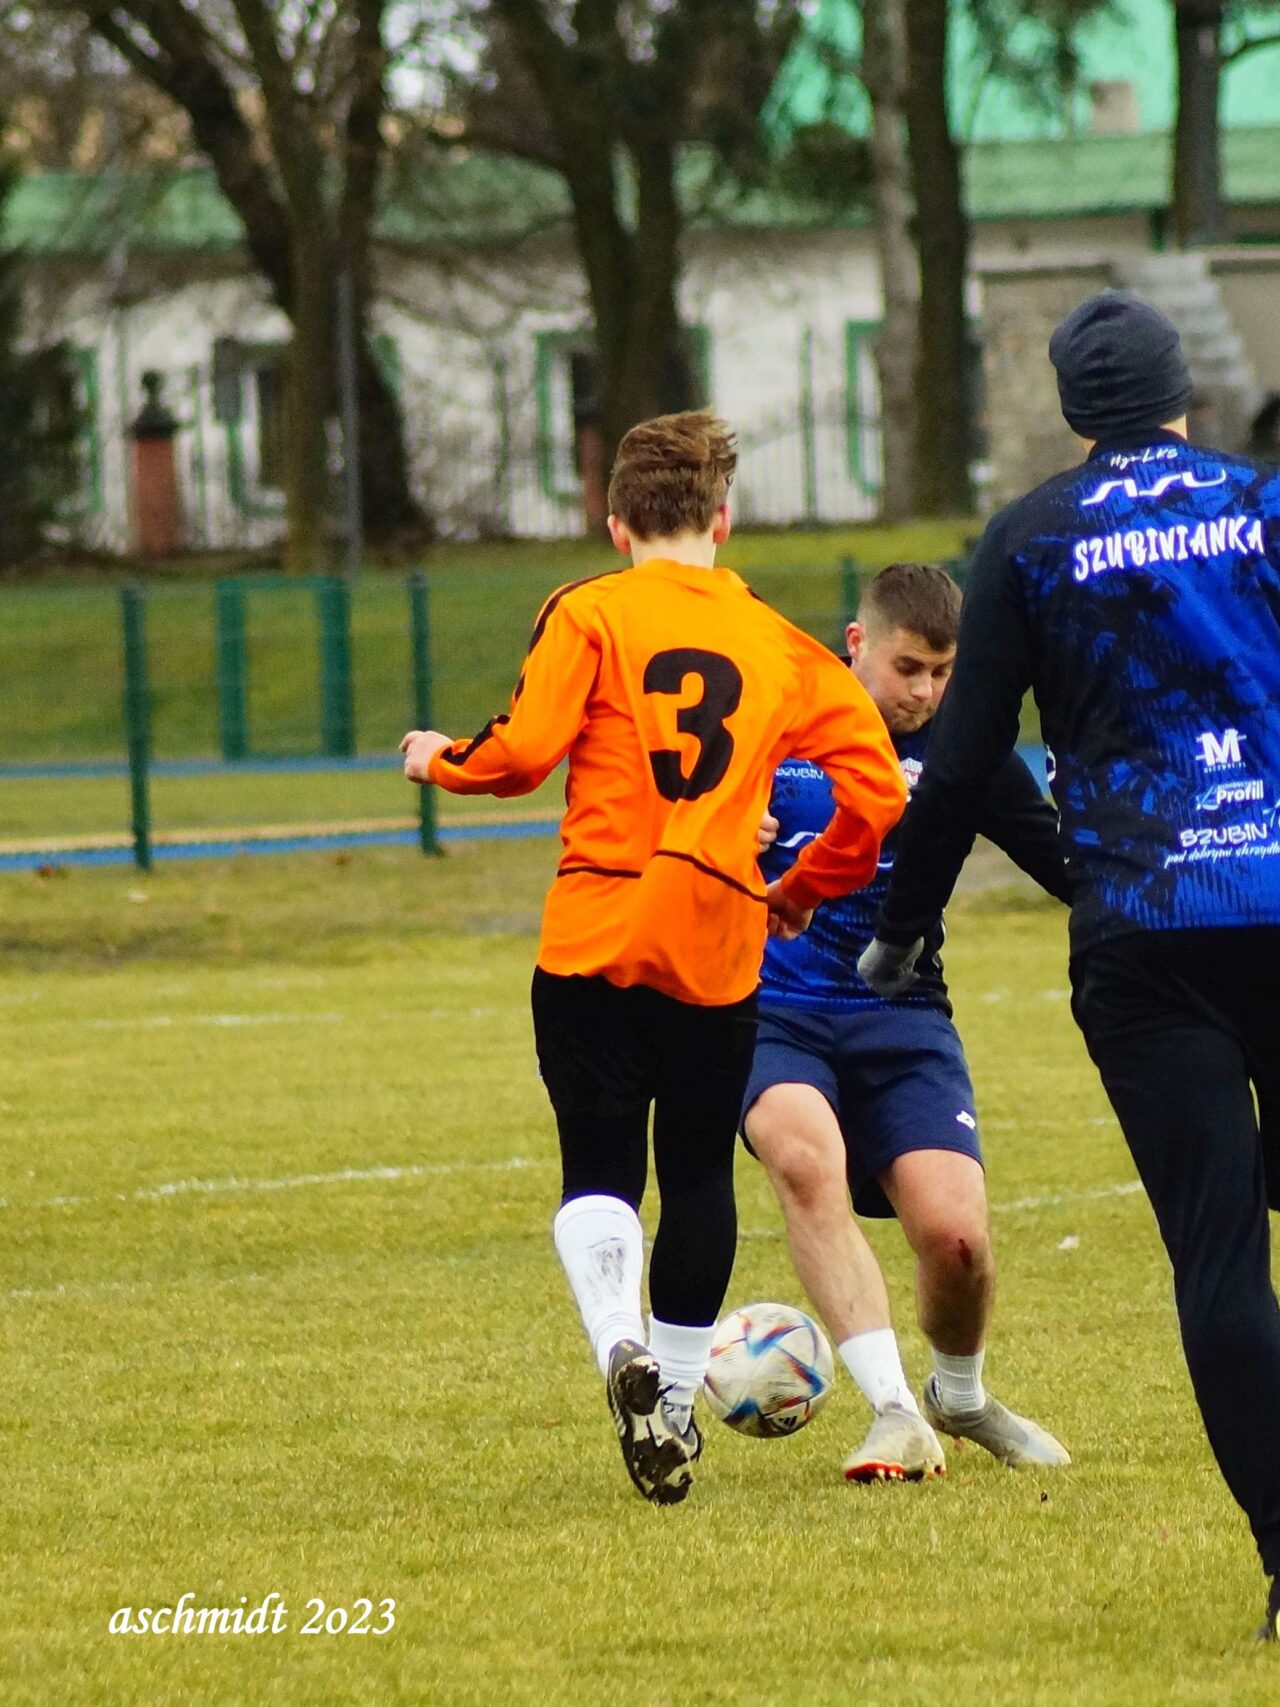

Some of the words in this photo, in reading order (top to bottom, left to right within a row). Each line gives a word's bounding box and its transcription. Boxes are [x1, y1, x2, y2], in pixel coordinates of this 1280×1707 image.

[1074, 516, 1264, 581] SZUBINIANKA
[643, 647, 743, 803] 3
[1217, 779, 1264, 803] Profill
[1180, 823, 1268, 848] SZUBIN
